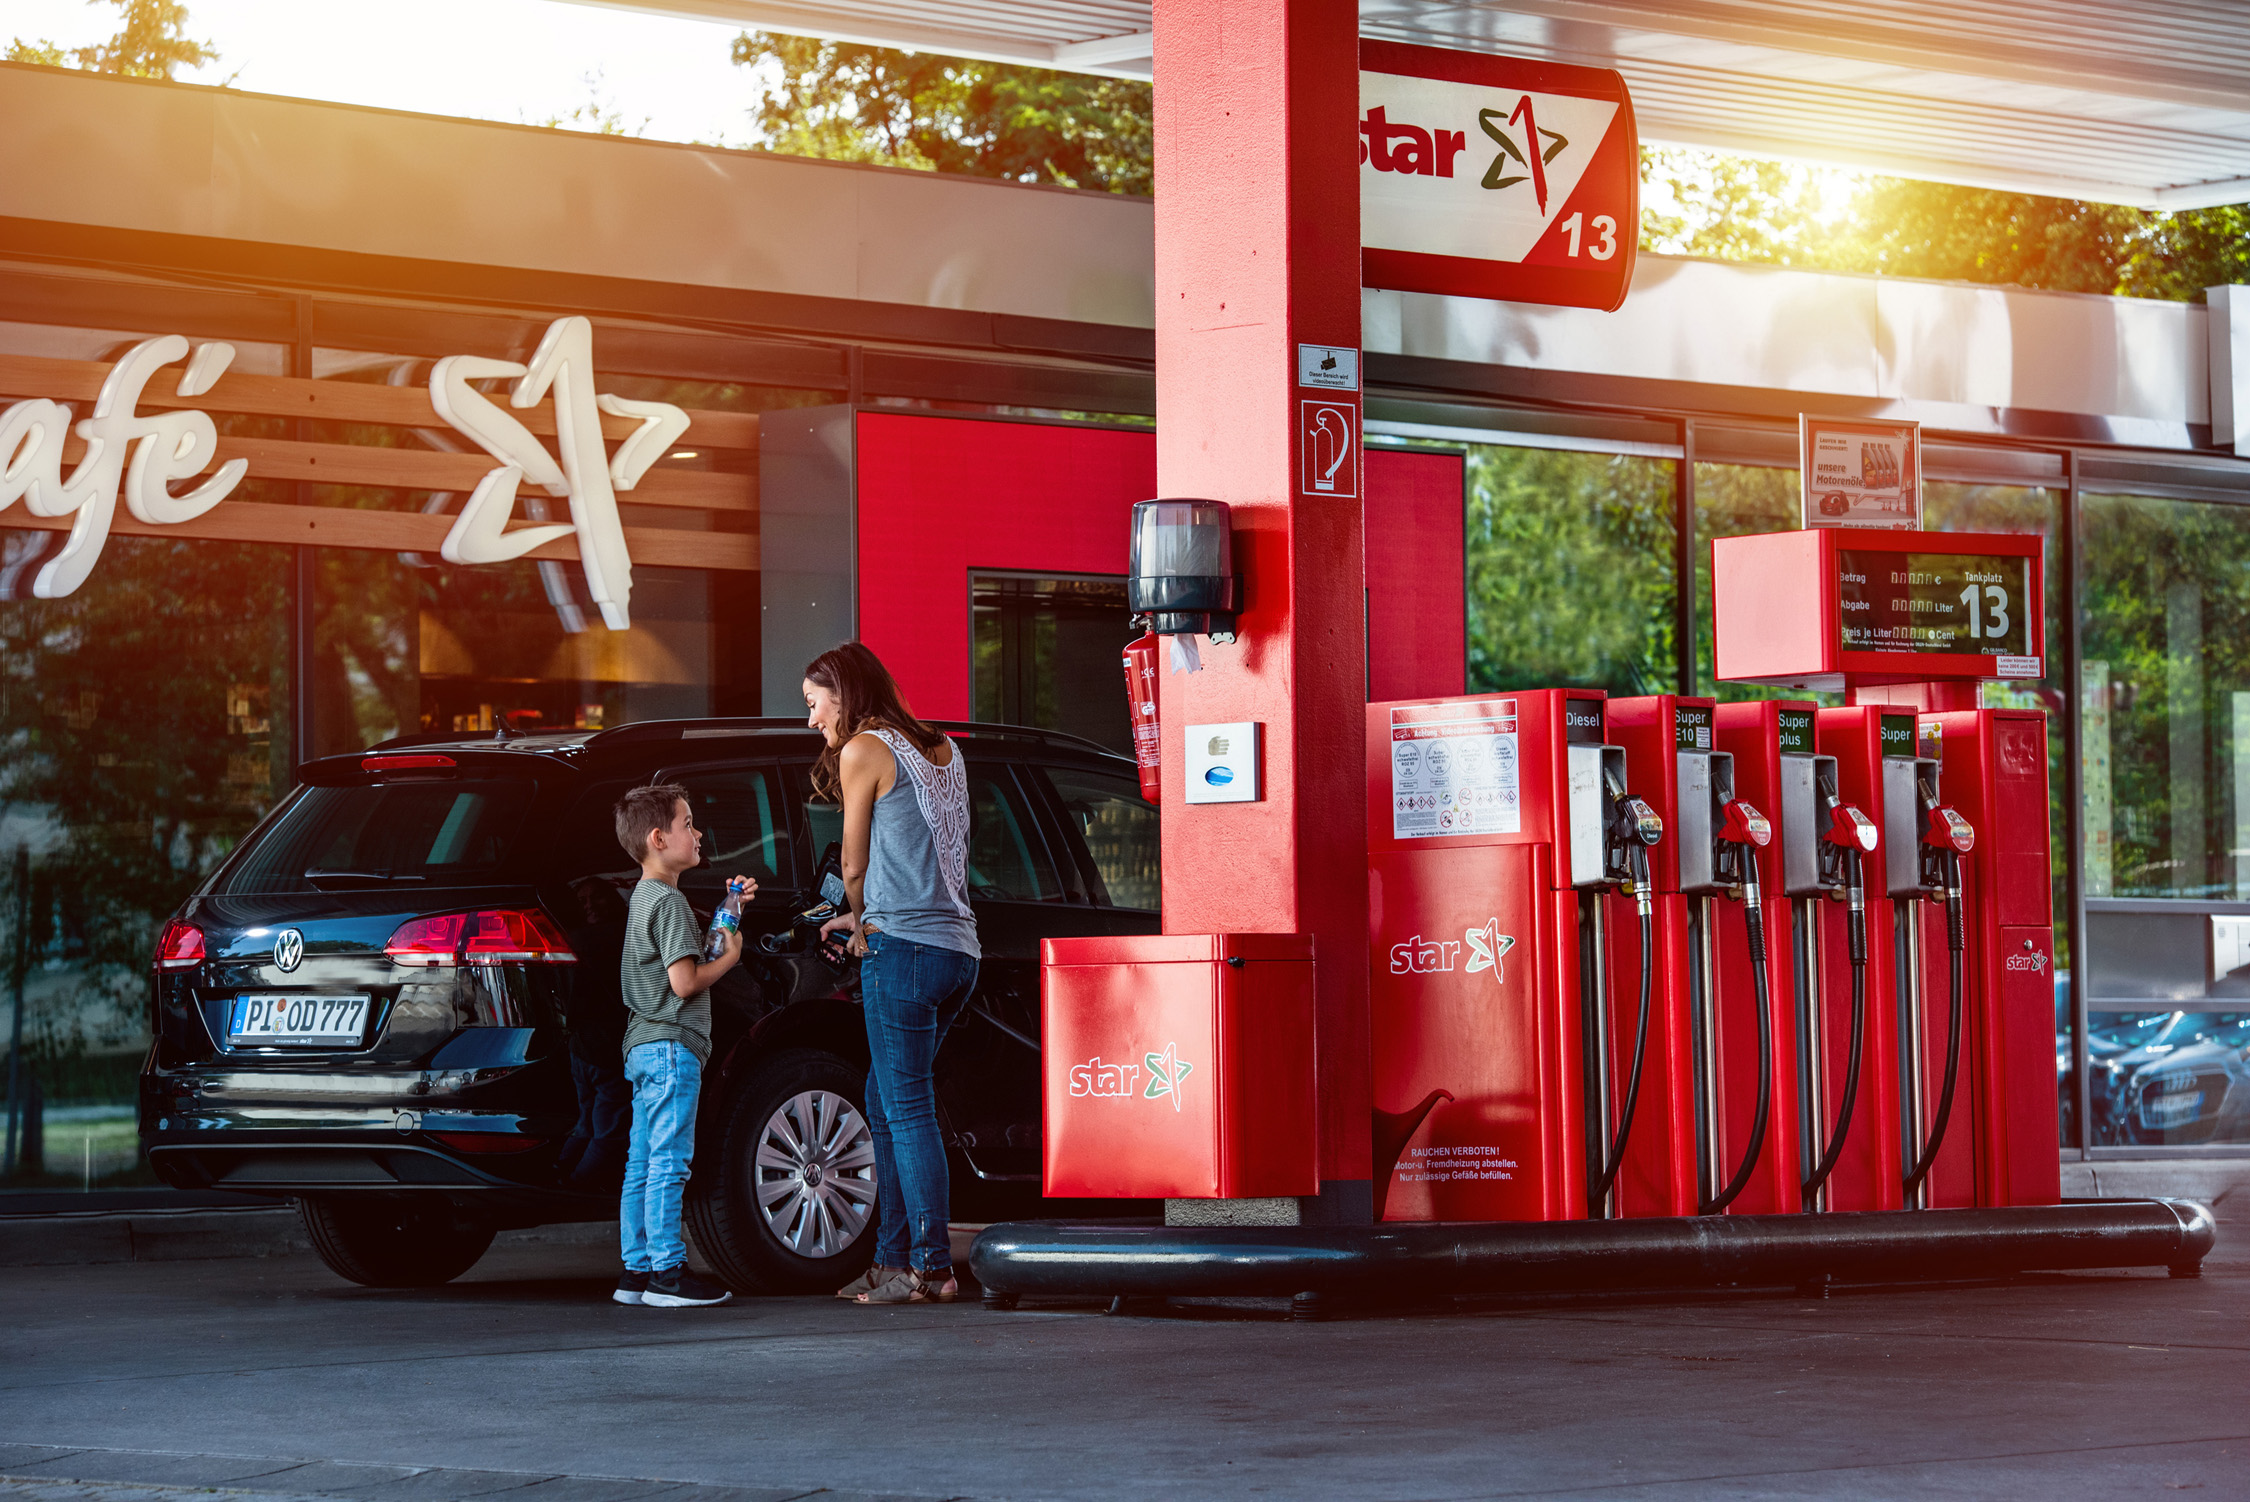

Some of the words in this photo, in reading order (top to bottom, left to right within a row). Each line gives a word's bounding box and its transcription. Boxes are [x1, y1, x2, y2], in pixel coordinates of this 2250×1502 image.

[1561, 212, 1617, 261] 13
[1818, 463, 1847, 473] unsere
[1816, 474, 1866, 487] Motorenöle.
[1840, 572, 1866, 584] Betrag
[1965, 571, 2003, 584] Tankplatz
[1841, 600, 1870, 611] Abgabe
[1935, 603, 1954, 613] Liter
[1960, 584, 2009, 638] 13
[1842, 627, 1861, 637] Preis
[1864, 627, 1871, 639] je
[1874, 628, 1892, 638] Liter
[1936, 630, 1955, 640] Cent
[1567, 712, 1599, 726] Diesel
[1675, 709, 1706, 725] Super
[1779, 714, 1809, 730] Super
[1676, 728, 1694, 741] E10
[1779, 731, 1801, 748] plus
[1881, 726, 1911, 743] Super
[1390, 935, 1460, 974] star
[2007, 954, 2030, 970] star
[247, 1000, 274, 1031] PI
[320, 1001, 364, 1031] 777
[1070, 1057, 1139, 1096] star
[1411, 1147, 1450, 1157] RAUCHEN
[1452, 1146, 1500, 1156] VERBOTEN!
[1426, 1159, 1480, 1169] Fremdheizung
[1482, 1159, 1518, 1168] abstellen.
[1400, 1173, 1412, 1181] Nur
[1415, 1171, 1450, 1182] zulässige
[1452, 1170, 1478, 1180] Gefäße
[1480, 1170, 1513, 1180] befüllen.
